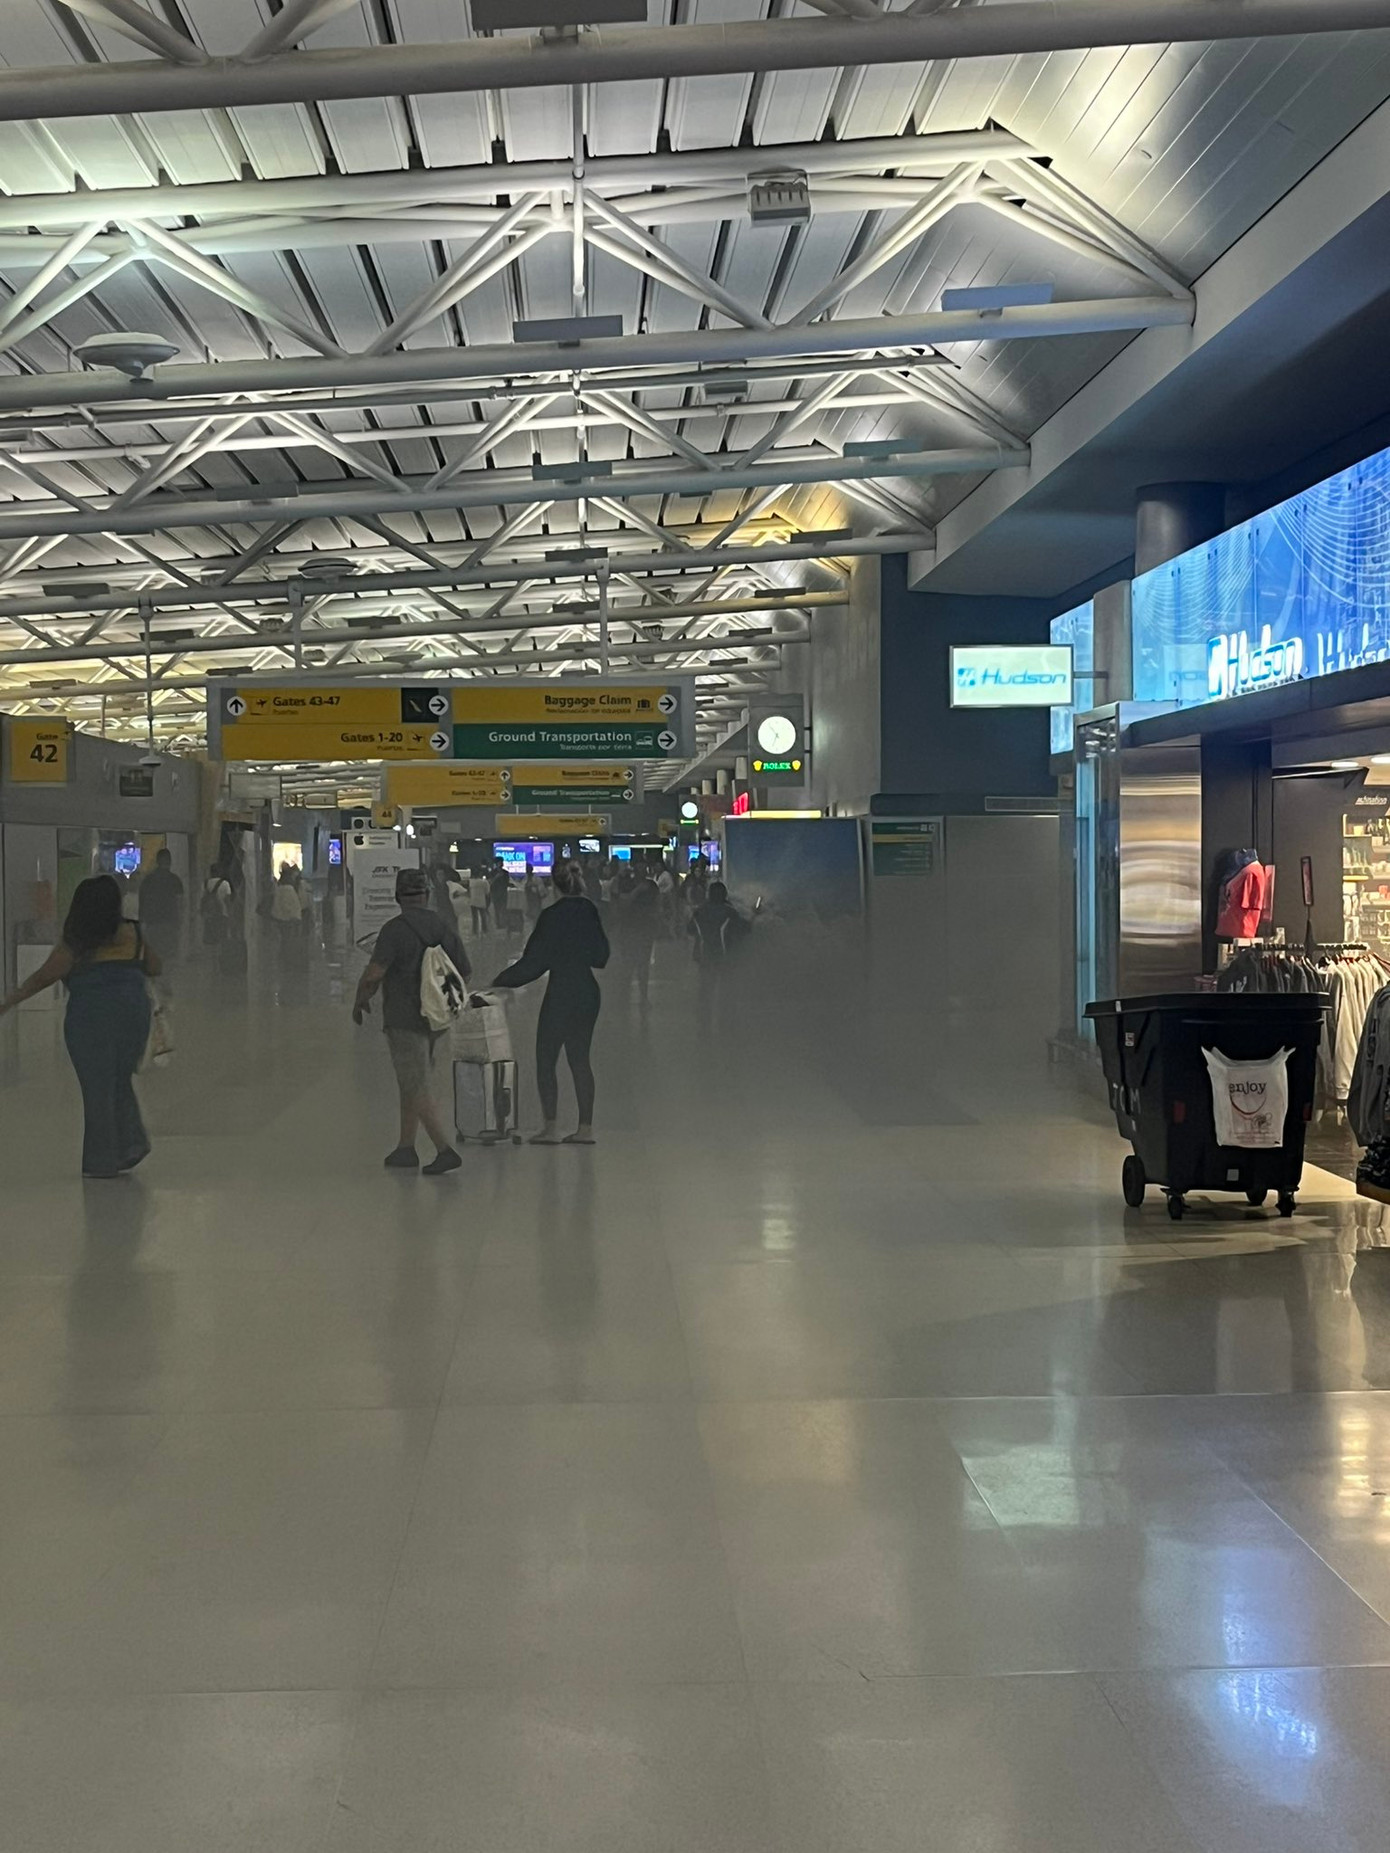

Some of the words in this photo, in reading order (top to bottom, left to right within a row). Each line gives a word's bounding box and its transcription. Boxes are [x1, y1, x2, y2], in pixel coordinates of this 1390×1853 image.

[1228, 624, 1303, 697] Hudson
[981, 667, 1067, 685] Hudson
[273, 696, 305, 707] Gates
[309, 696, 340, 707] 43-47
[545, 695, 596, 707] Baggage
[599, 695, 632, 706] Claim
[340, 732, 375, 743] Gates
[378, 732, 403, 743] 1-20
[488, 732, 536, 743] Ground
[539, 731, 632, 744] Transportation
[30, 744, 58, 763] 42
[763, 762, 791, 770] ROLEX
[1228, 1081, 1267, 1095] enjoy
